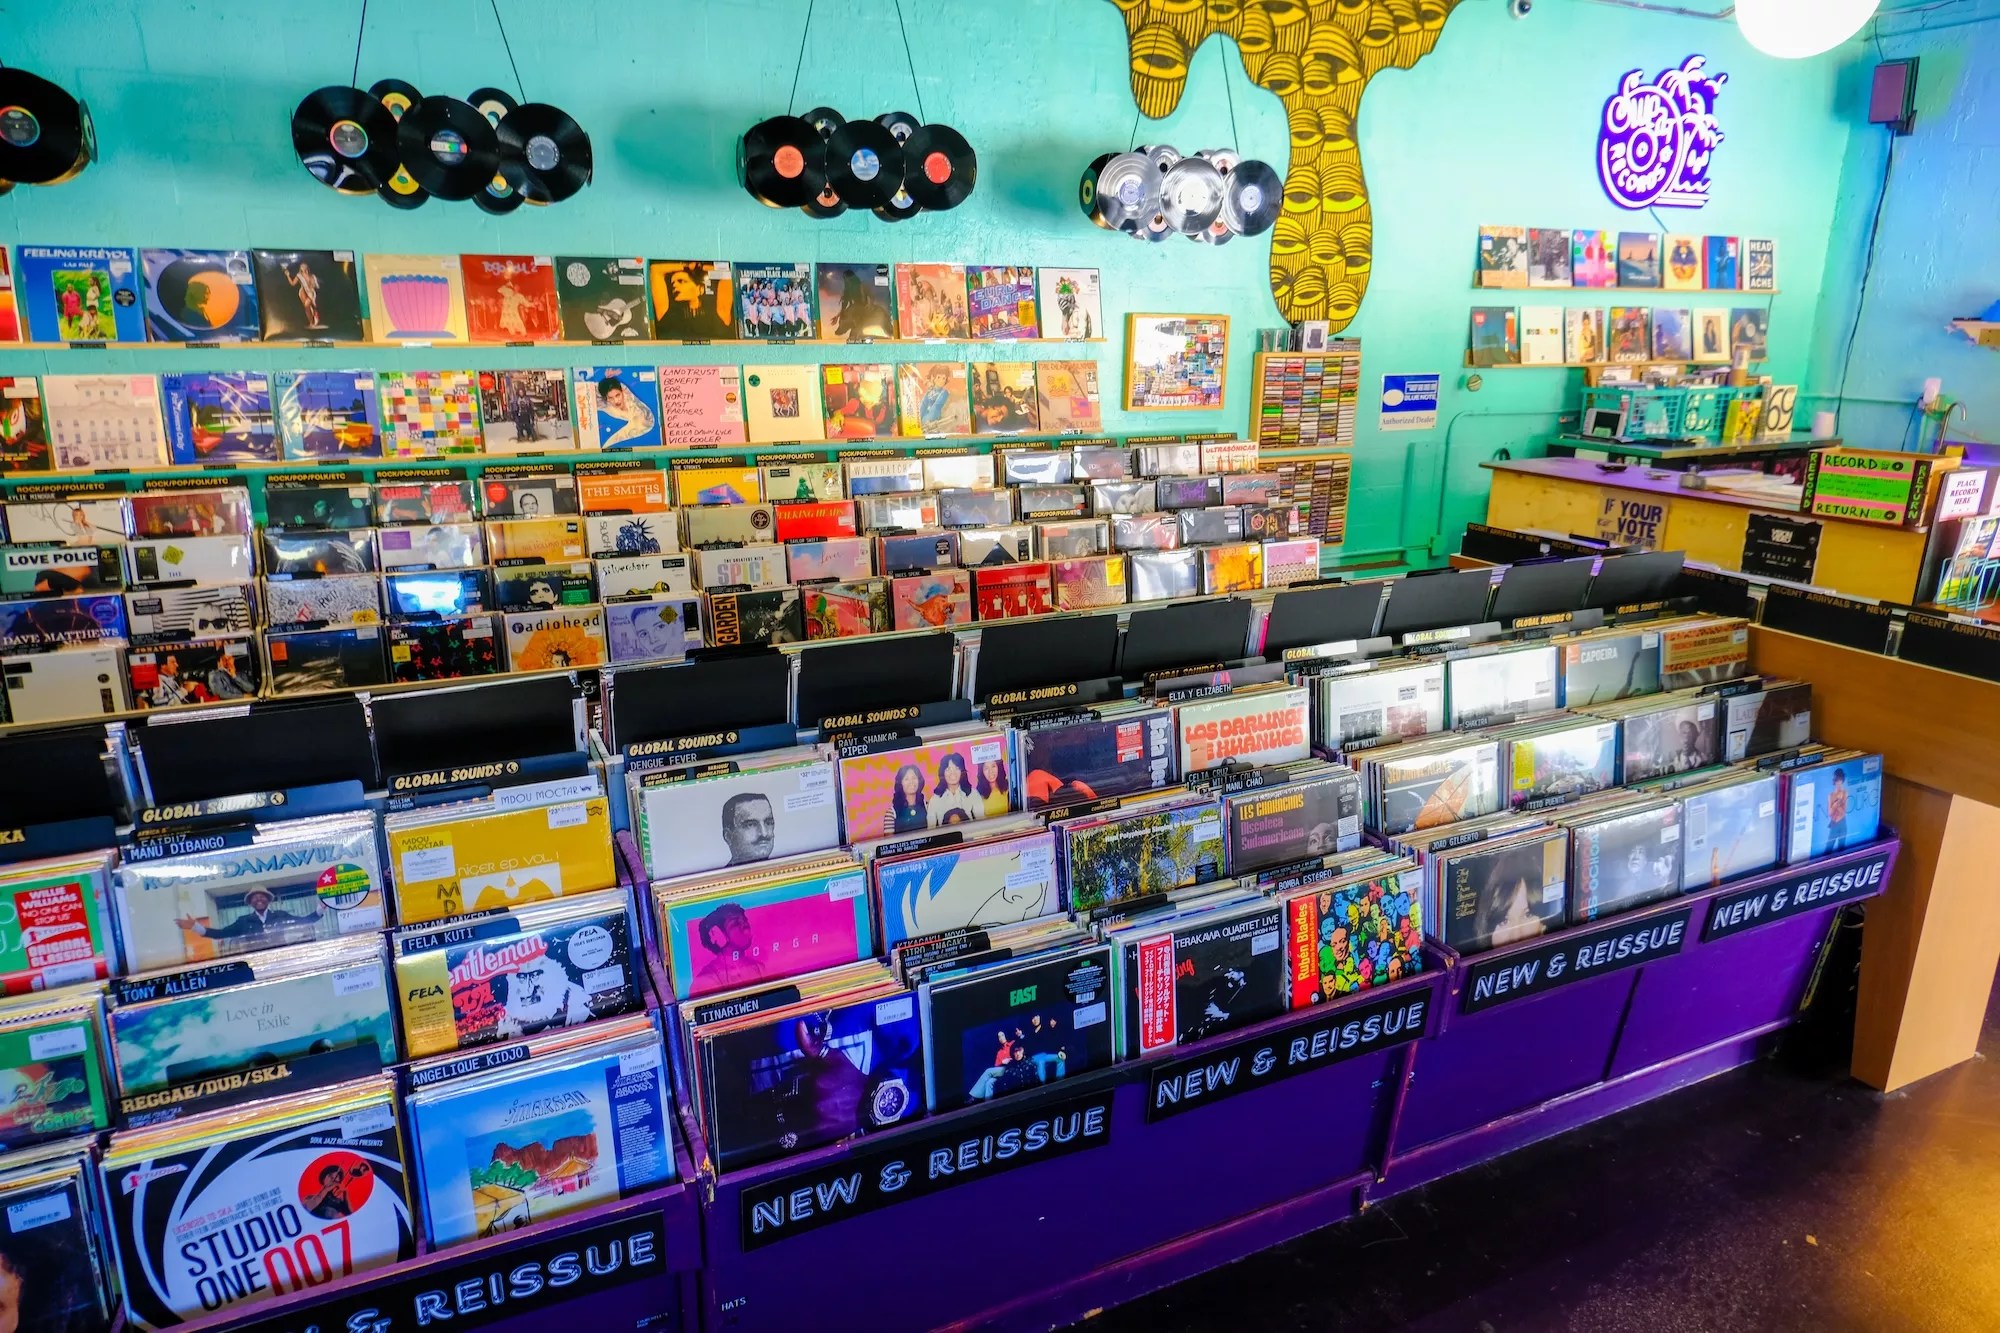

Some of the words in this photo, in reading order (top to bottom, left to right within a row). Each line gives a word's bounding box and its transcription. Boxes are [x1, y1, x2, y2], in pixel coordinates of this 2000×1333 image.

[1750, 241, 1772, 251] HEAD
[1750, 277, 1772, 288] ACHE
[1383, 416, 1415, 424] Authorized
[1825, 455, 1877, 470] RECORD
[16, 483, 105, 493] ROCK/POP/FOLK/ETC
[145, 478, 228, 488] ROCK/POP/FOLK/ETC
[1803, 453, 1818, 508] RECORD
[1957, 479, 1977, 487] PLACE
[585, 486, 611, 497] THE
[613, 484, 660, 495] SMITHS
[1908, 465, 1926, 519] RETURN
[1950, 488, 1979, 496] RECORDS
[1604, 498, 1616, 515] IF
[1954, 497, 1971, 505] HERE
[1621, 501, 1662, 522] YOUR
[1816, 503, 1870, 518] RETURN
[1618, 518, 1656, 539] VOTE
[9, 554, 49, 566] LOVE
[1770, 585, 1802, 598] RECENT
[1806, 592, 1850, 609] ARRIVALS
[1866, 605, 1891, 616] NEW
[714, 594, 739, 644] GARDEN
[1515, 617, 1538, 628] GLOBAL
[1908, 614, 1948, 630] RECENT
[3, 634, 39, 645] DAVE
[44, 628, 119, 642] MATTHEWS
[1287, 648, 1316, 660] GLOBAL
[1580, 647, 1618, 663] CAPOEIRA
[991, 691, 1027, 705] GLOBAL
[1029, 685, 1066, 699] SOUNDS
[1188, 689, 1195, 697] Y
[1196, 685, 1232, 697] ELIZABETH
[824, 715, 864, 729] GLOBAL
[867, 708, 907, 722] SOUNDS
[629, 740, 674, 757] GLOBAL
[678, 733, 724, 750] SOUNDS
[863, 732, 898, 744] SHANKAR
[842, 745, 868, 757] PIPER
[630, 756, 665, 770] DENGUE
[669, 752, 697, 766] FEVER
[394, 772, 447, 790] GLOBAL
[450, 764, 504, 782] SOUNDS
[1213, 768, 1229, 777] CRUZ
[1226, 781, 1244, 792] MANU
[1246, 776, 1263, 787] CHAO
[501, 790, 532, 804] MDOU
[535, 786, 578, 799] MOCTAR
[142, 803, 202, 823] GLOBAL
[1049, 808, 1069, 820] ASIA
[130, 844, 164, 860] MANU
[170, 836, 225, 855] DIBANGO
[402, 836, 429, 846] MDOU
[407, 841, 444, 851] MOCTAR
[1278, 879, 1300, 890] BOMBA
[1303, 870, 1333, 884] ESTÉREO
[21, 893, 77, 909] WILLIAMS
[28, 886, 66, 900] WILLIE
[1712, 898, 1765, 931] NEW
[1773, 891, 1789, 911] &
[1793, 862, 1884, 906] REISSUE
[1101, 914, 1126, 926] TWICE
[1295, 903, 1309, 943] Blades
[578, 929, 598, 938] FELA
[1174, 931, 1221, 949] TERAKAWA
[1222, 919, 1261, 937] QUARTET
[1262, 914, 1279, 927] LIVE
[408, 937, 438, 951] FELA
[444, 931, 473, 944] KUTI
[1297, 944, 1310, 981] Rubén
[1474, 959, 1541, 1002] NEW
[1546, 953, 1568, 979] &
[1574, 920, 1685, 971] REISSUE
[121, 987, 155, 1002] TONY
[164, 976, 207, 994] ALLEN
[408, 985, 443, 1001] FELA
[1010, 985, 1037, 1006] EAST
[226, 1005, 258, 1022] Love
[261, 1001, 274, 1014] in
[701, 1000, 759, 1022] TINARIWEN
[257, 1014, 291, 1032] Exile
[1156, 1057, 1240, 1109] NEW
[1252, 1048, 1278, 1076] &
[1288, 1001, 1425, 1066] REISSUE
[412, 1059, 480, 1086] ANGELIQUE
[485, 1047, 523, 1068] KIDJO
[121, 1063, 292, 1114] REGGAE/DUB/SKA
[323, 1137, 335, 1145] JAZZ
[359, 1139, 383, 1147] PRESENTS
[752, 1173, 862, 1234] NEW
[879, 1161, 912, 1192] &
[928, 1106, 1105, 1180] REISSUE
[181, 1203, 301, 1277] STUDIO
[195, 1257, 266, 1311] ONE
[263, 1220, 353, 1296] 007
[413, 1231, 656, 1327] REISSUE
[721, 1298, 747, 1312] HATS
